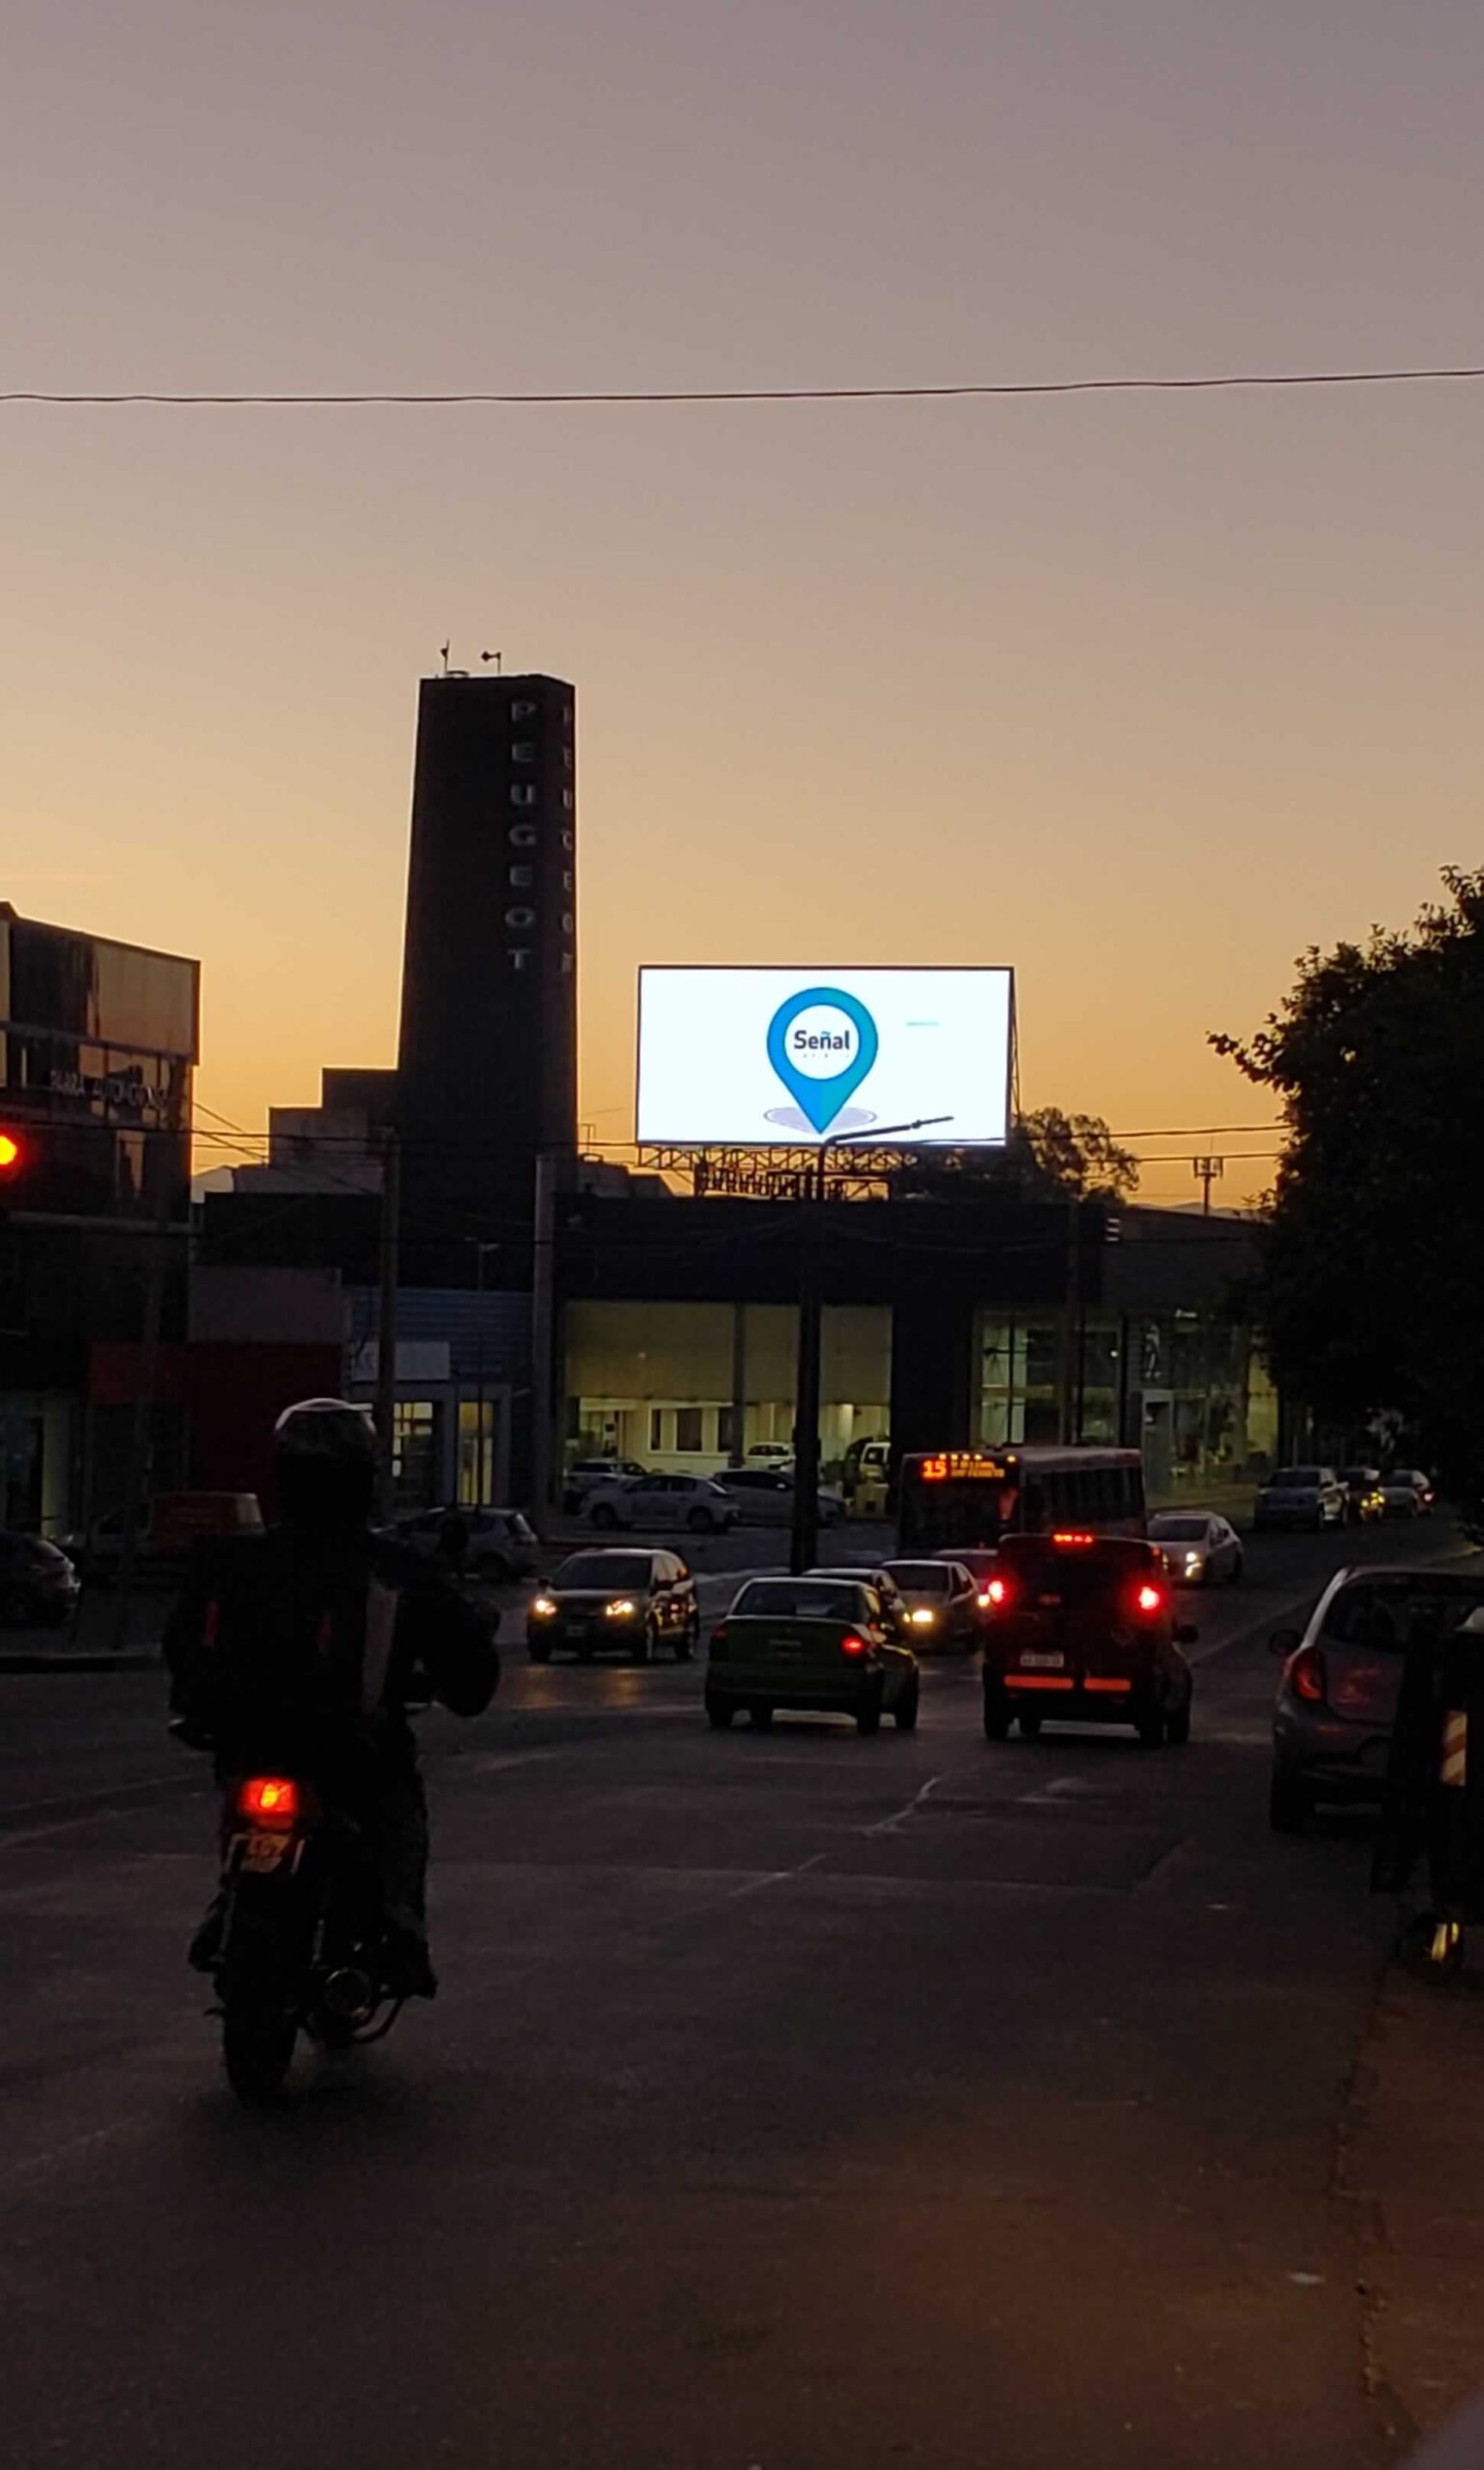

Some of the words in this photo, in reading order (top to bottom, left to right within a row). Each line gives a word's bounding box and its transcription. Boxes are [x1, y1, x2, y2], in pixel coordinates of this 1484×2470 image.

[505, 700, 537, 971] PEUGEOT
[793, 1029, 850, 1050] Señal
[923, 1460, 947, 1478] 15
